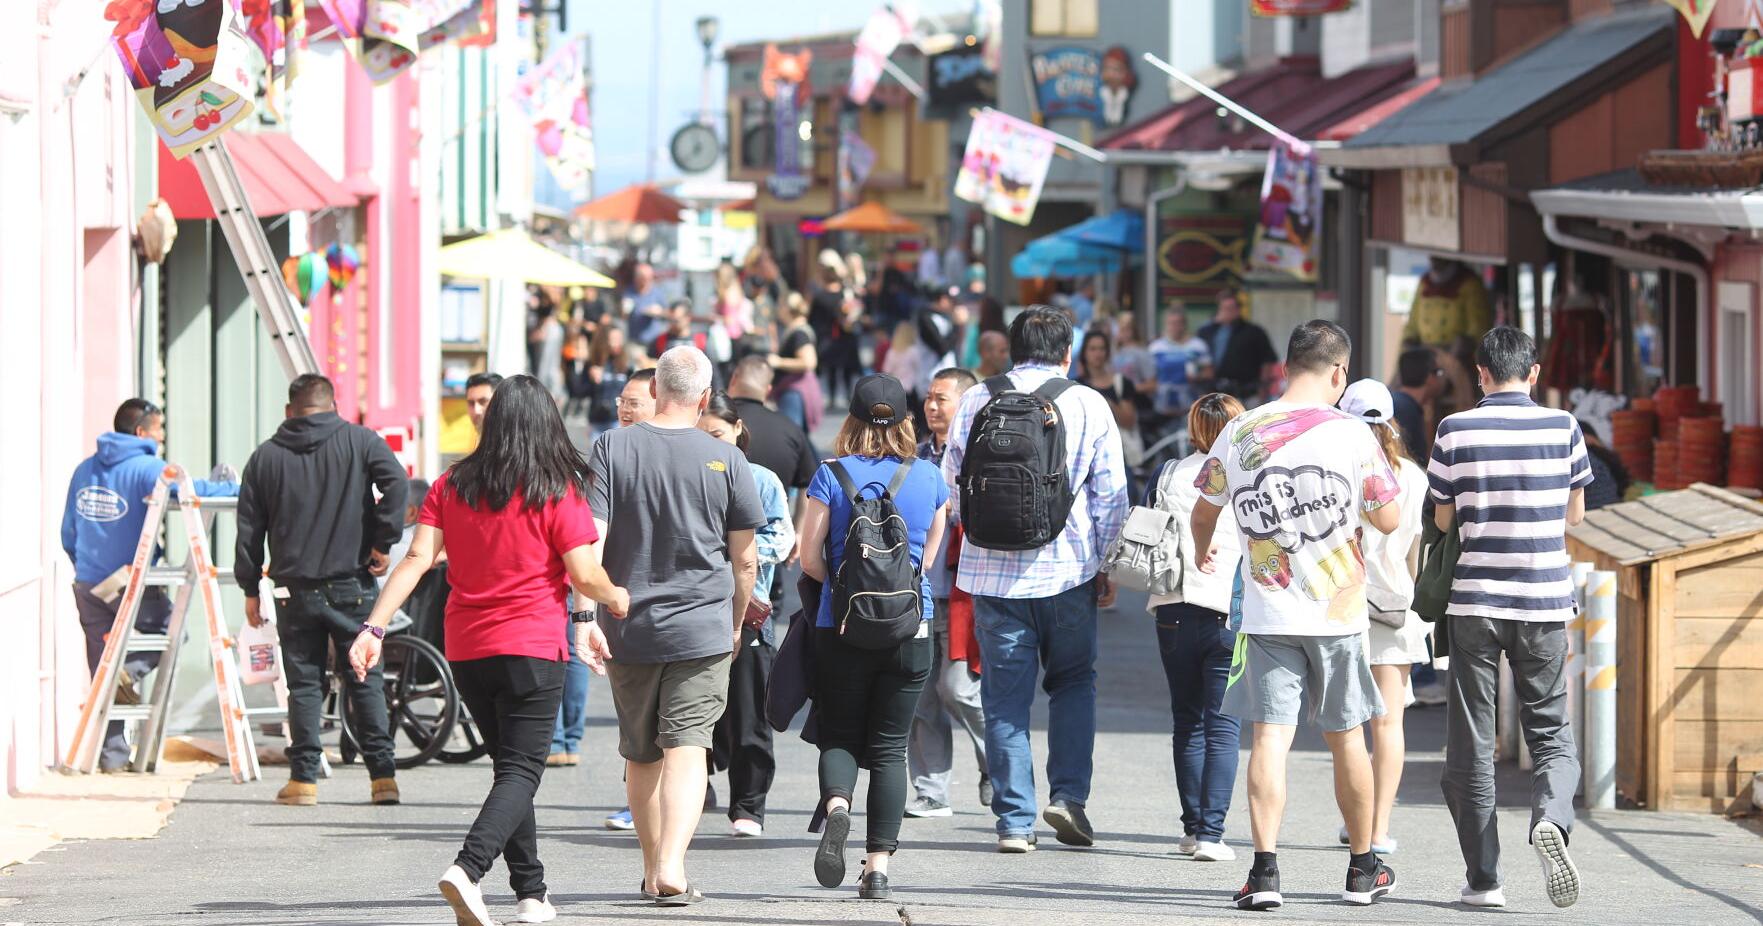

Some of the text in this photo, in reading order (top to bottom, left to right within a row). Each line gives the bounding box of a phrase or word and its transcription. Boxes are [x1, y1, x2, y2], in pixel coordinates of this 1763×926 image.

[1239, 481, 1295, 516] This is
[1260, 493, 1338, 529] Madness
